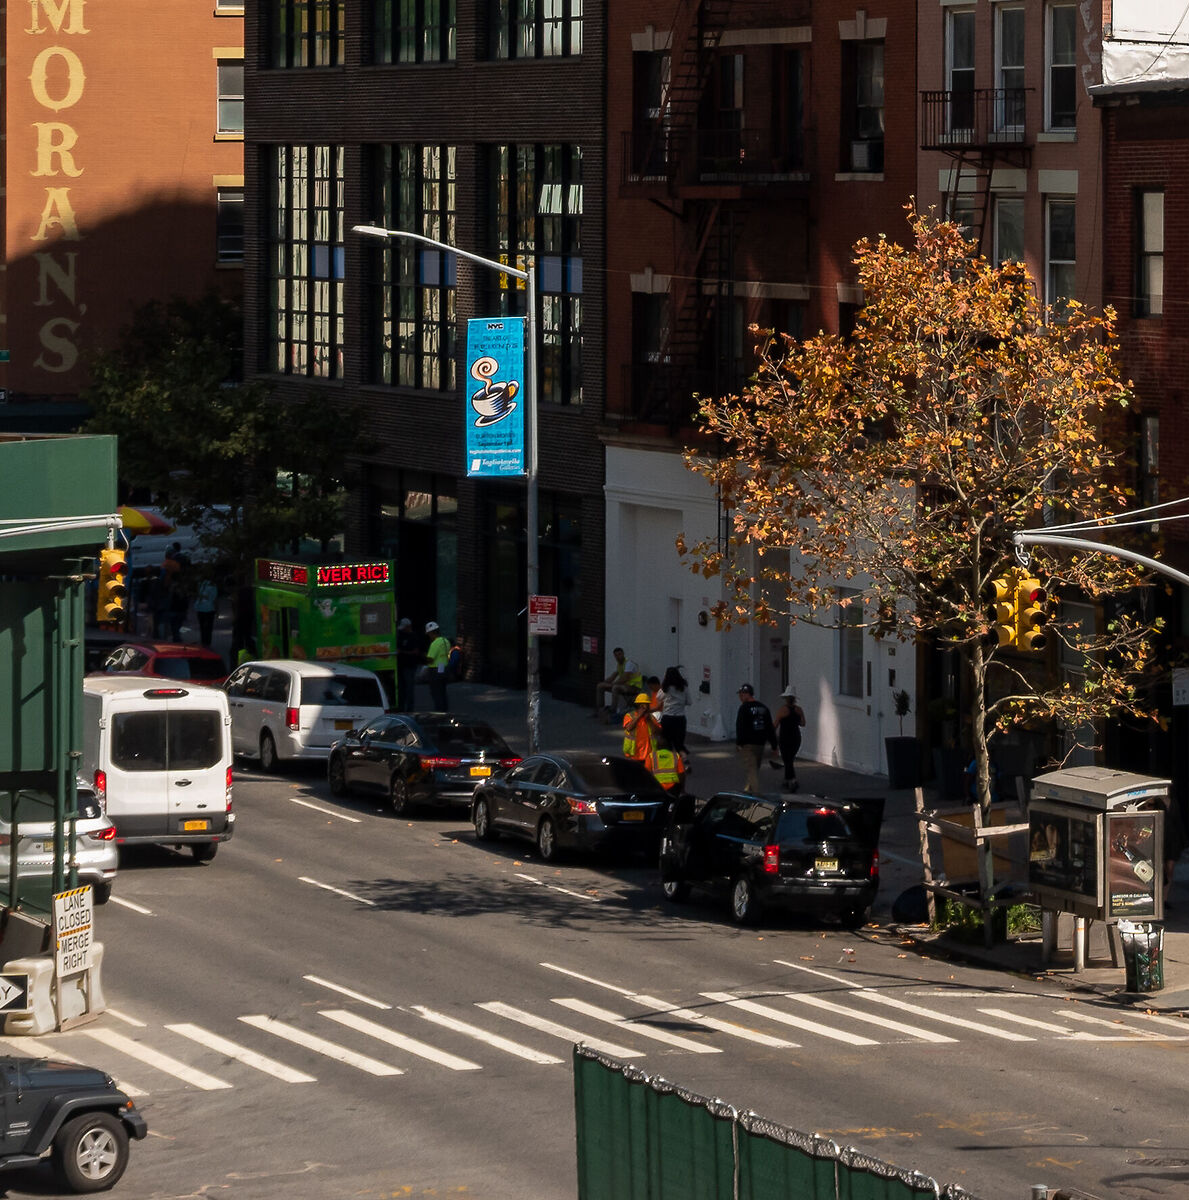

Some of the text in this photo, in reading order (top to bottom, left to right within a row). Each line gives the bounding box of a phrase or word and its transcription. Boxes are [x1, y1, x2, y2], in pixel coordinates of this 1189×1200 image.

[487, 322, 504, 330] NYC
[64, 893, 85, 912] LANE
[58, 909, 91, 931] CLOSED
[61, 933, 89, 954] MERGE
[63, 951, 88, 971] RIGHT
